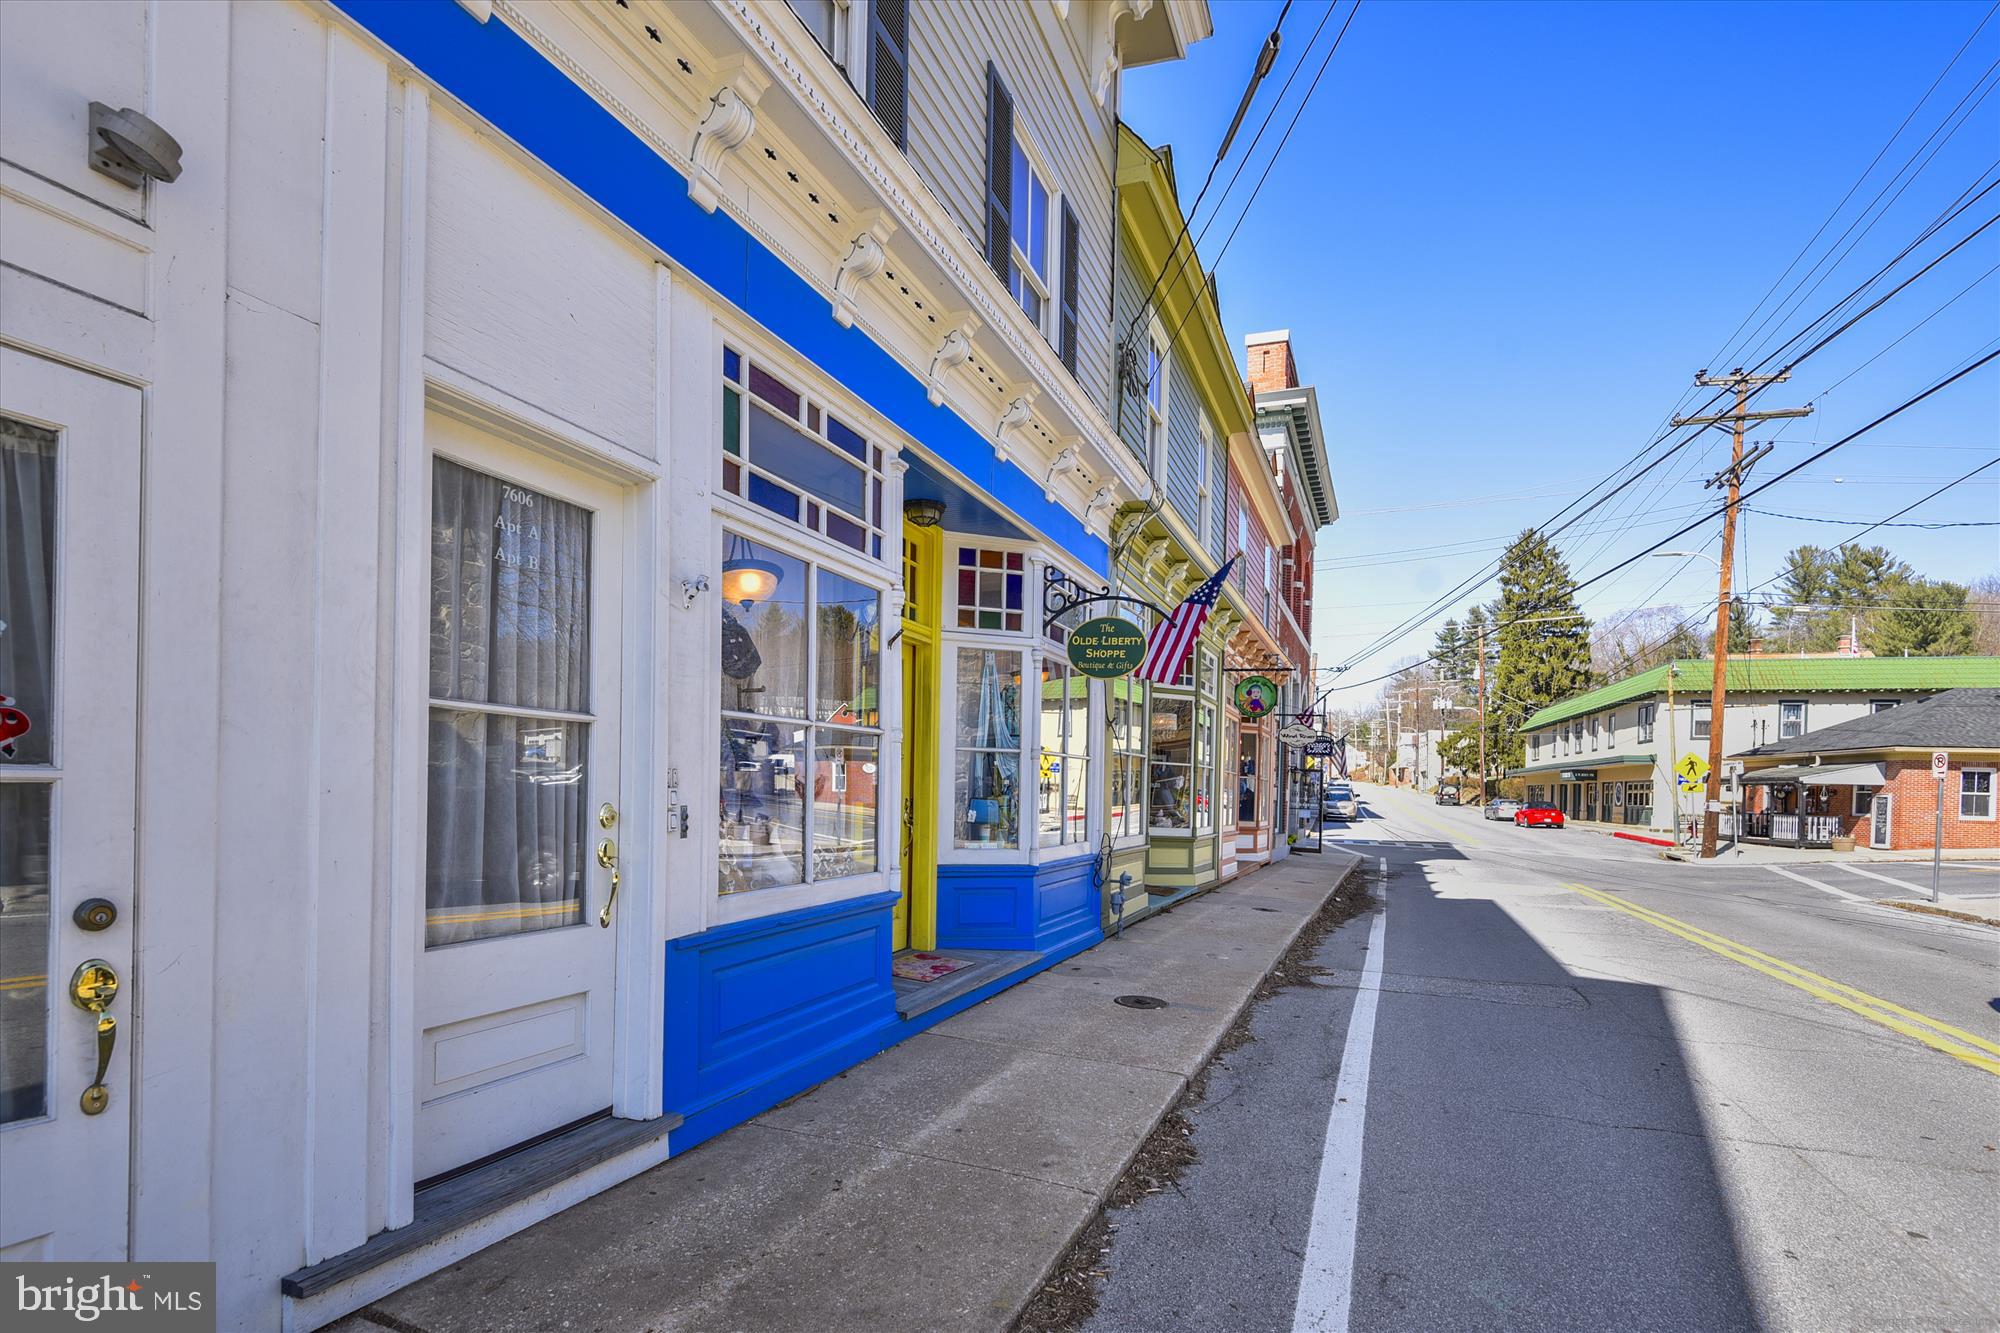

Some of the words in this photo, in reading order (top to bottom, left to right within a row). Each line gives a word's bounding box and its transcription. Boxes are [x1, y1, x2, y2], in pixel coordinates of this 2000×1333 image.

[502, 485, 533, 508] 7606
[494, 515, 522, 536] Apt
[528, 526, 539, 540] A
[494, 546, 522, 567] Apt
[528, 555, 538, 570] B
[1100, 623, 1115, 633] The
[1072, 636, 1098, 646] OLDE
[1102, 636, 1143, 646] LIBERTY
[1086, 649, 1126, 658] SHOPPE
[1078, 661, 1105, 671] Boutique
[1116, 662, 1133, 671] Gifts
